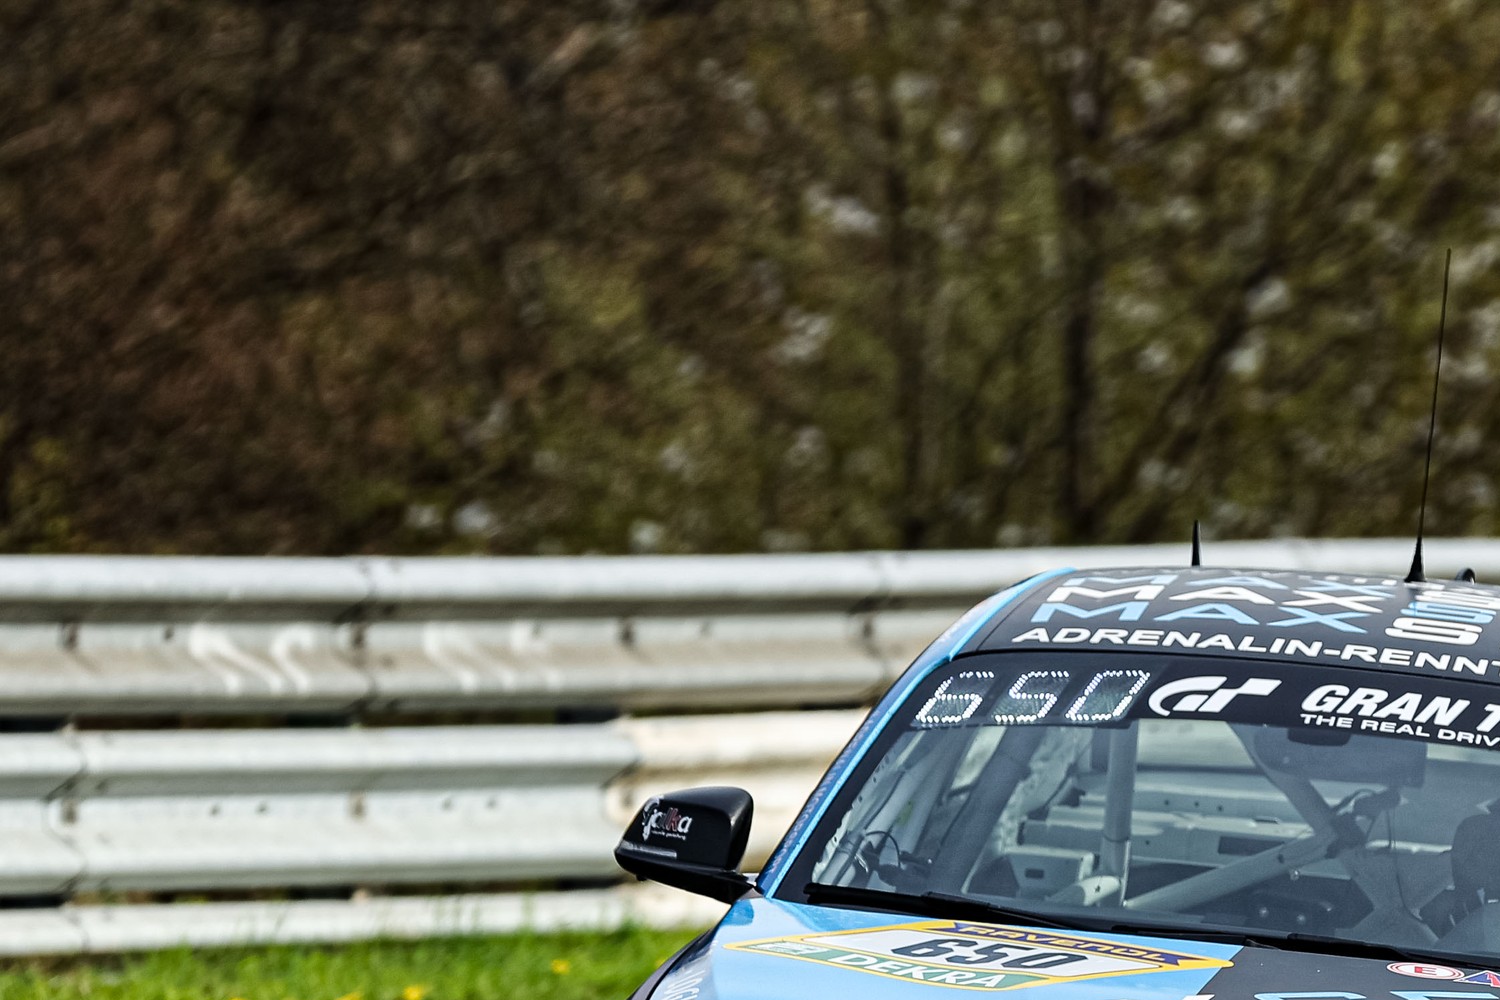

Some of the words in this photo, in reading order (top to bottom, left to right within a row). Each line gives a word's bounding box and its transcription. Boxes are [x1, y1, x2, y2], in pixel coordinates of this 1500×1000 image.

[915, 671, 1151, 723] 650
[1301, 684, 1470, 726] GRAN
[1300, 713, 1353, 729] THE
[1361, 720, 1431, 739] REAL
[891, 938, 1089, 971] 650
[959, 925, 1168, 962] RAVENOL
[828, 951, 1007, 989] DEKRA
